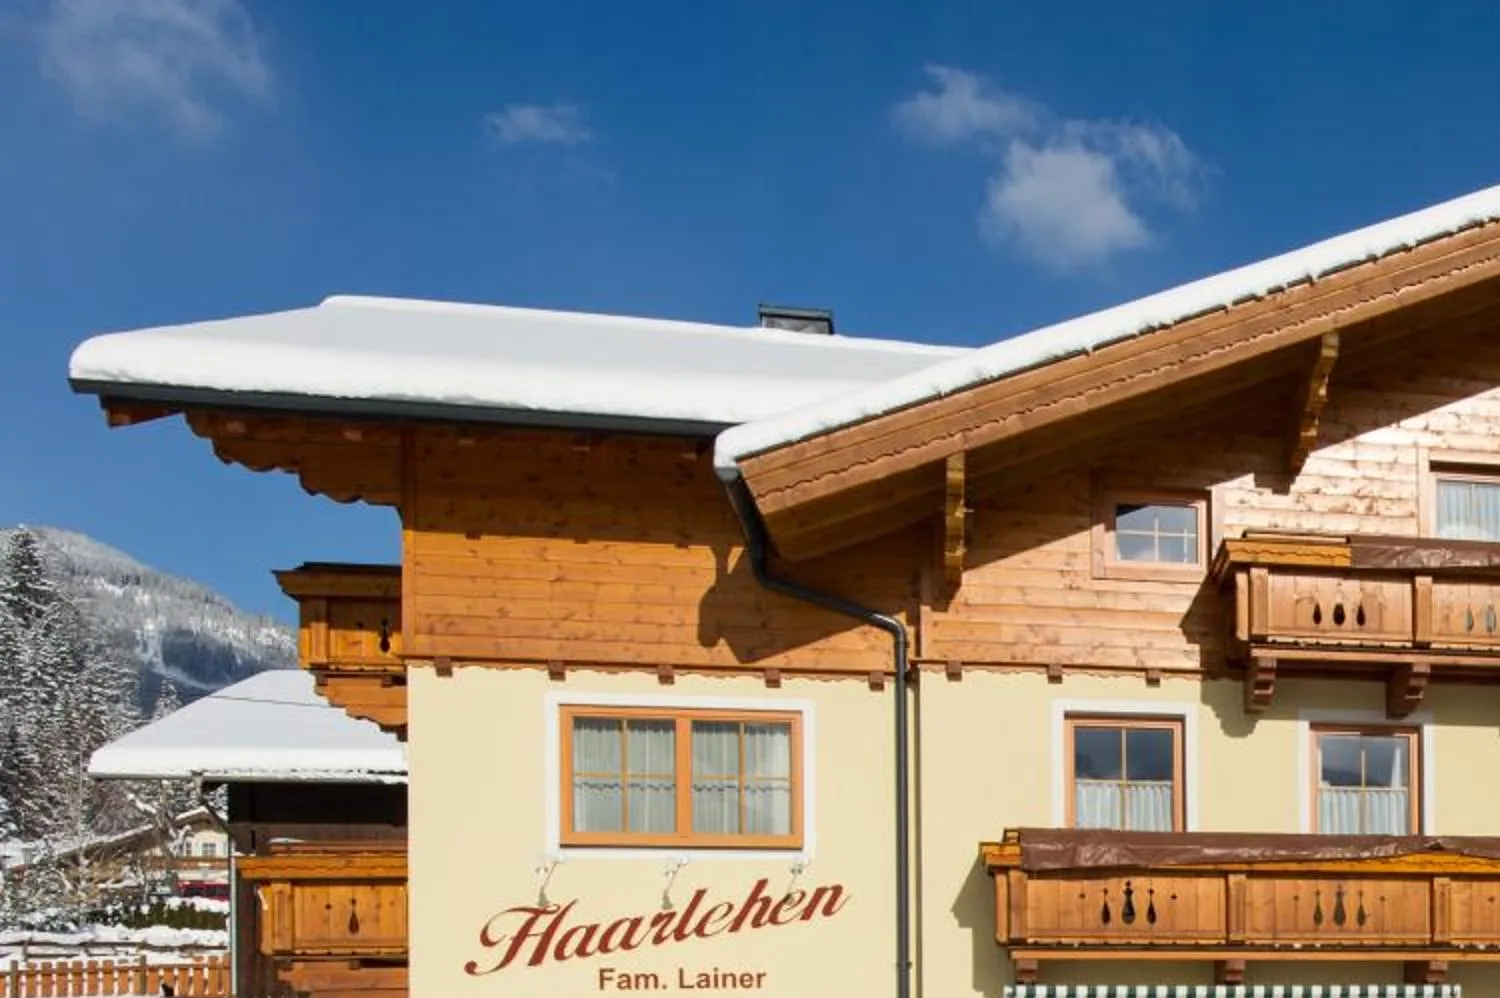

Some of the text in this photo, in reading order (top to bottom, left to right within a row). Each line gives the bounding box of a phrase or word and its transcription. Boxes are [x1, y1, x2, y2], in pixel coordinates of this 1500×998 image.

[463, 878, 851, 976] Haarlehen
[598, 966, 768, 991] Fam. Lainer
